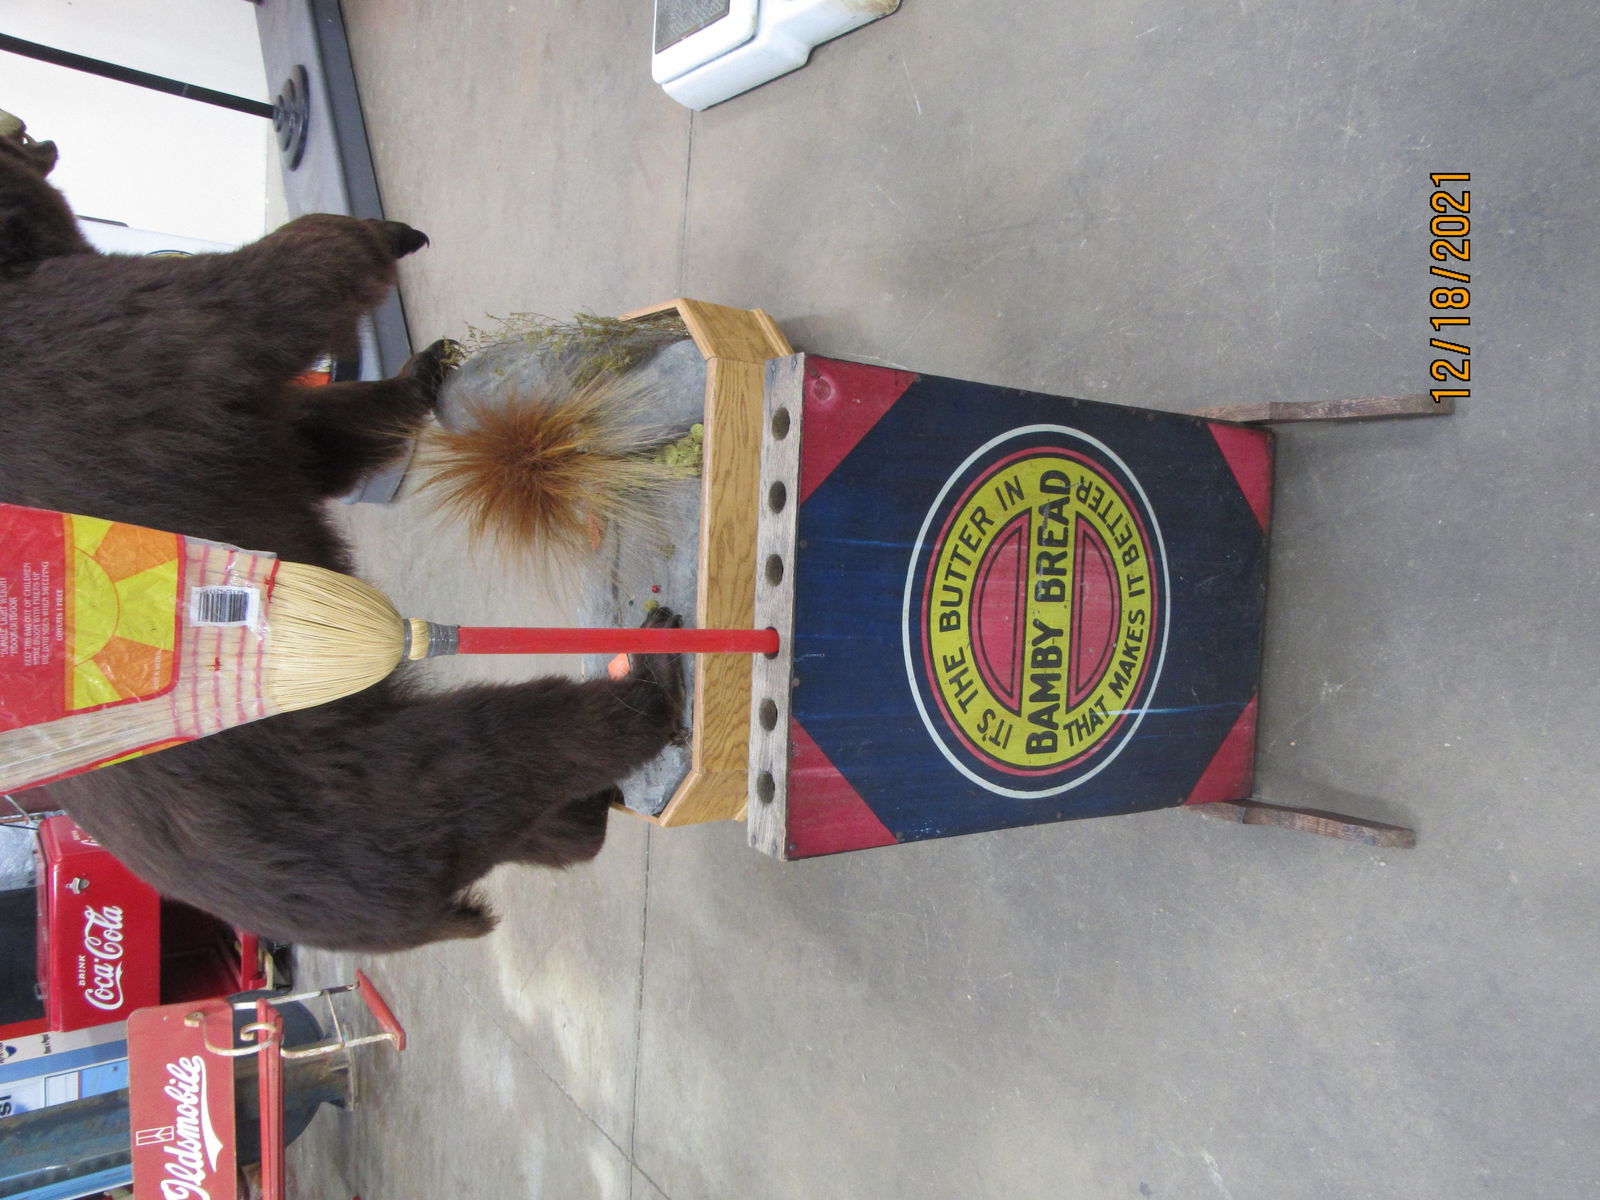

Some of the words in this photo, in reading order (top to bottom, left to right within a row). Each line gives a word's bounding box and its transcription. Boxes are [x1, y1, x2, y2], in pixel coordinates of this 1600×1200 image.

[994, 475, 1025, 510] IN
[1074, 475, 1142, 568] BETTER
[938, 505, 996, 633] BUTTER
[1034, 469, 1072, 604] BREAD
[1128, 574, 1146, 599] IT
[941, 646, 979, 713] THE
[1025, 618, 1065, 756] BAMBY
[1109, 608, 1145, 699] MAKES
[976, 708, 1013, 750] IT'S
[1062, 694, 1110, 747] THAT
[78, 955, 86, 987] DRINK
[84, 904, 124, 1011] Coca-Cola
